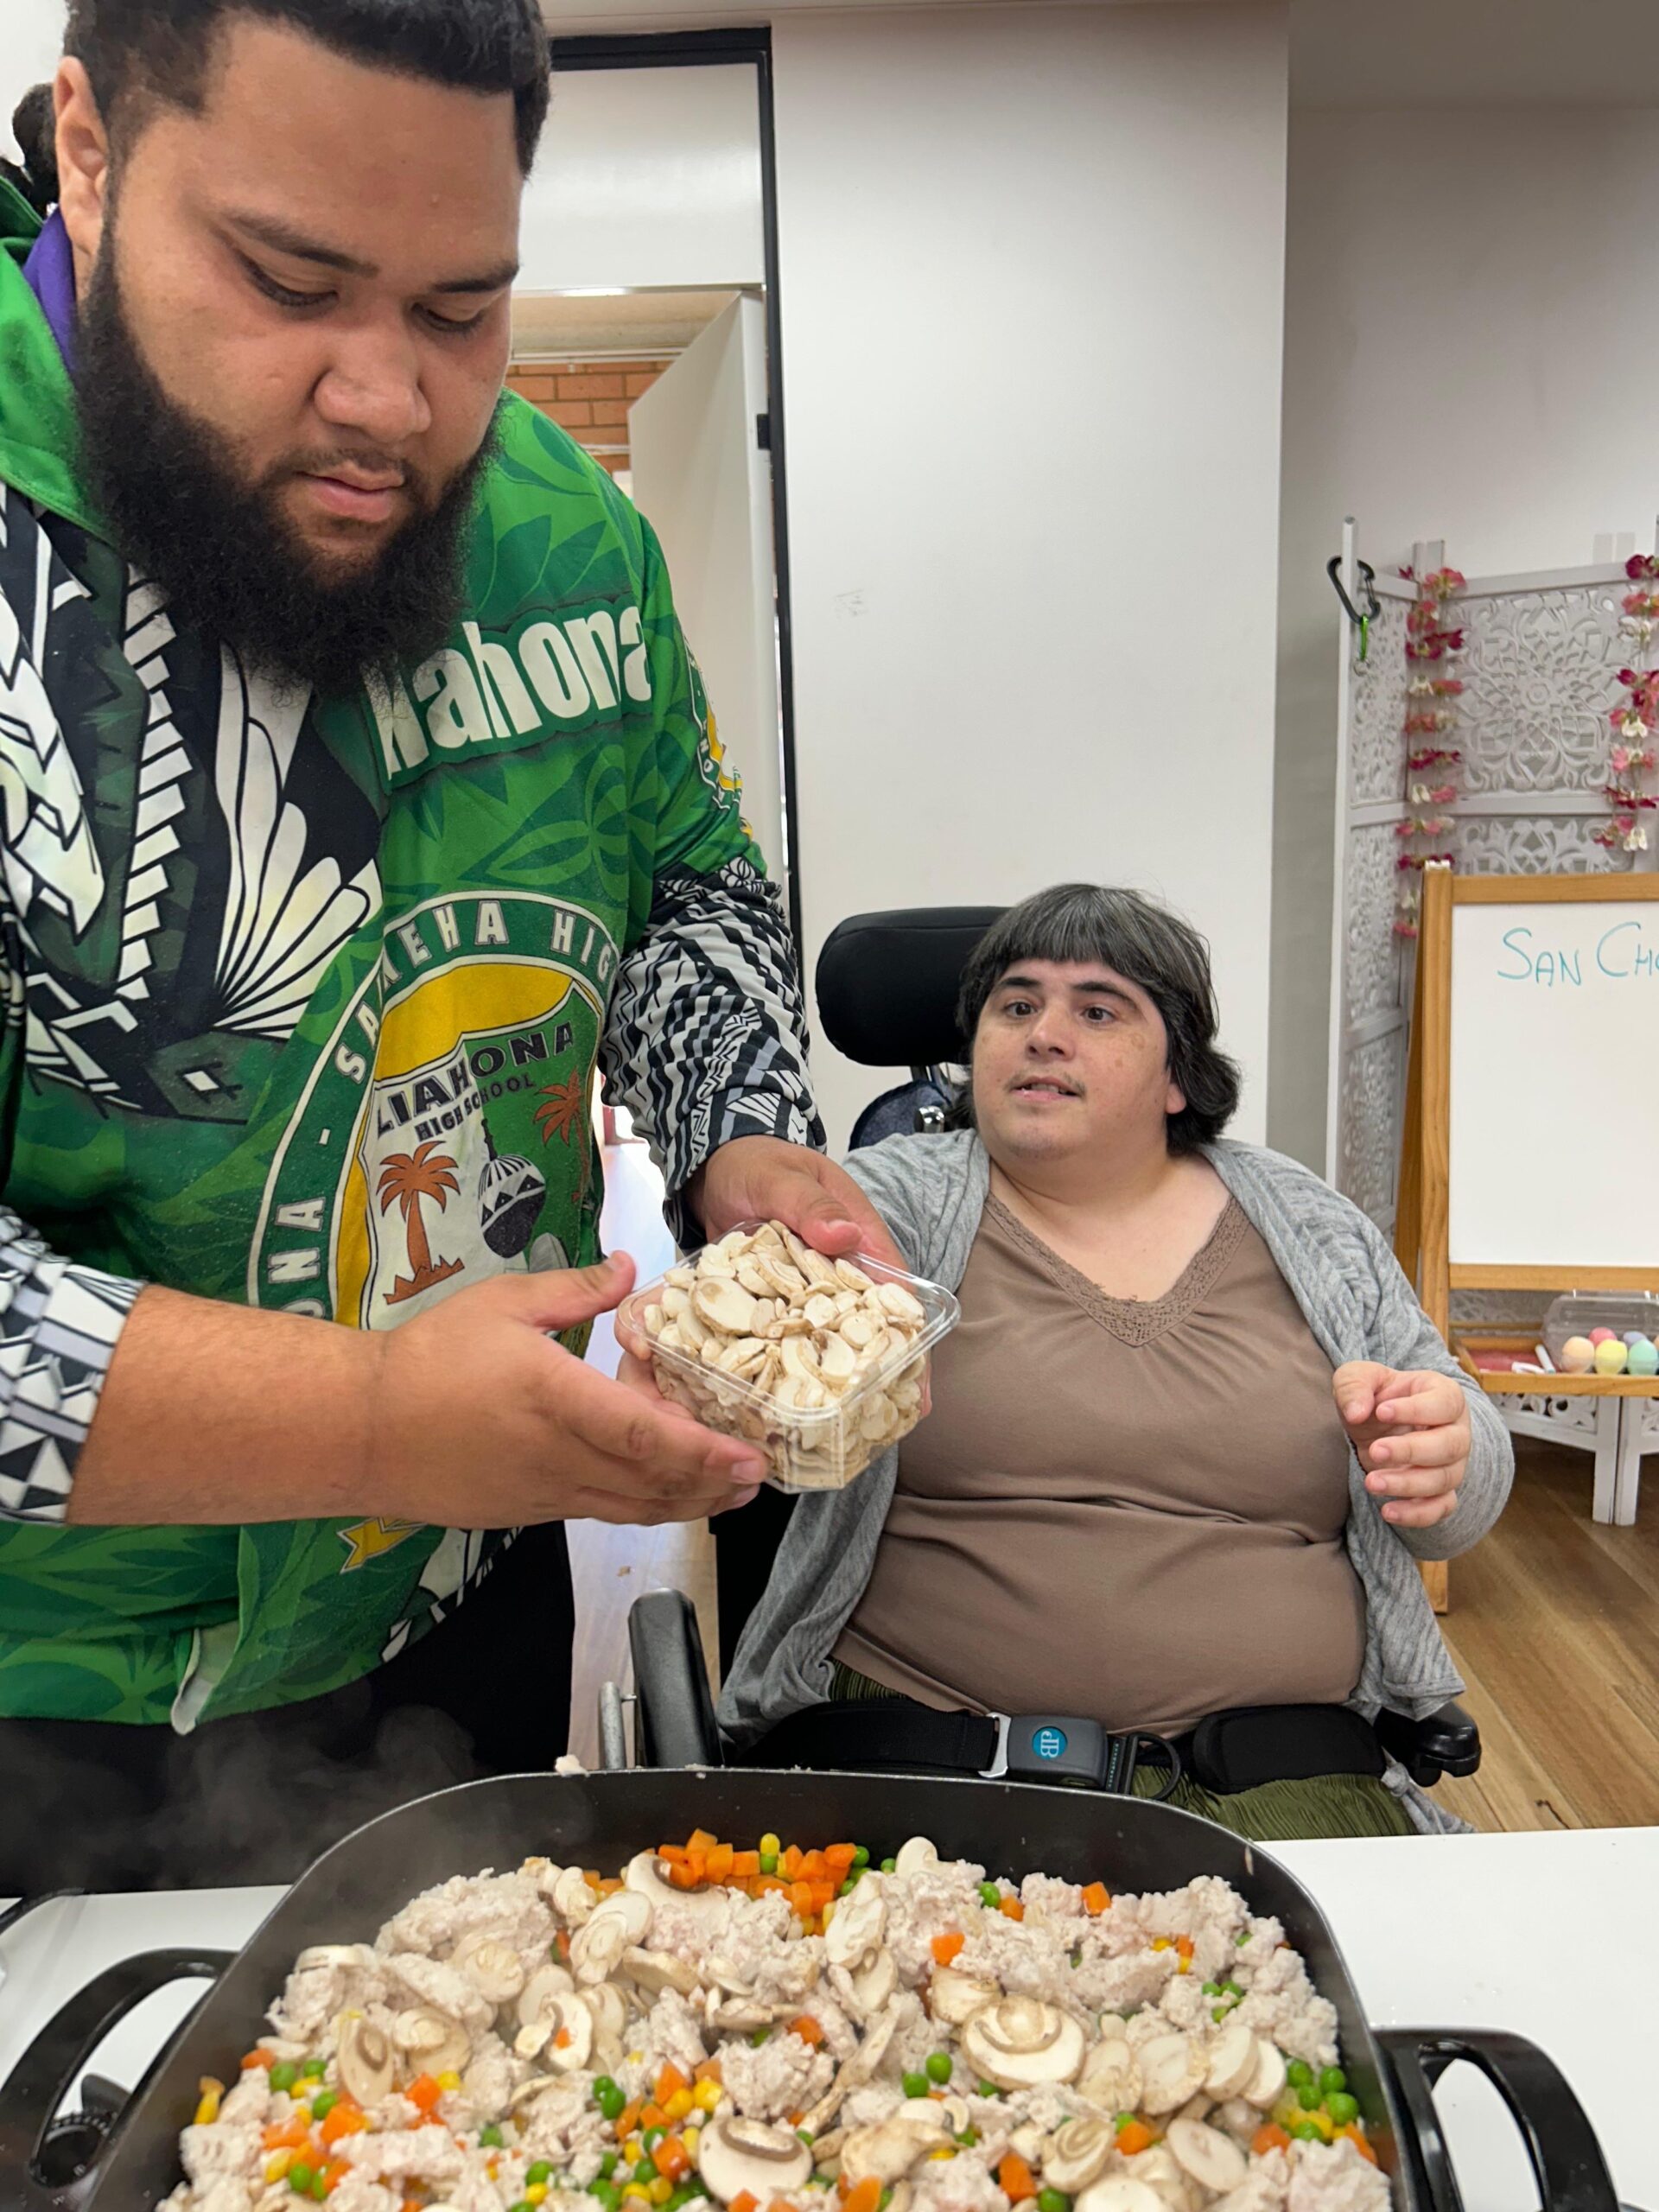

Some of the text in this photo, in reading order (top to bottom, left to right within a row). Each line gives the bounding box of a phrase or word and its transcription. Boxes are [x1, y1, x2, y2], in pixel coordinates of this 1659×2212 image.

[1596, 921, 1659, 977] CH
[377, 1020, 575, 1141] LIAHONA
[414, 1073, 537, 1143] HIGH SCHOOL
